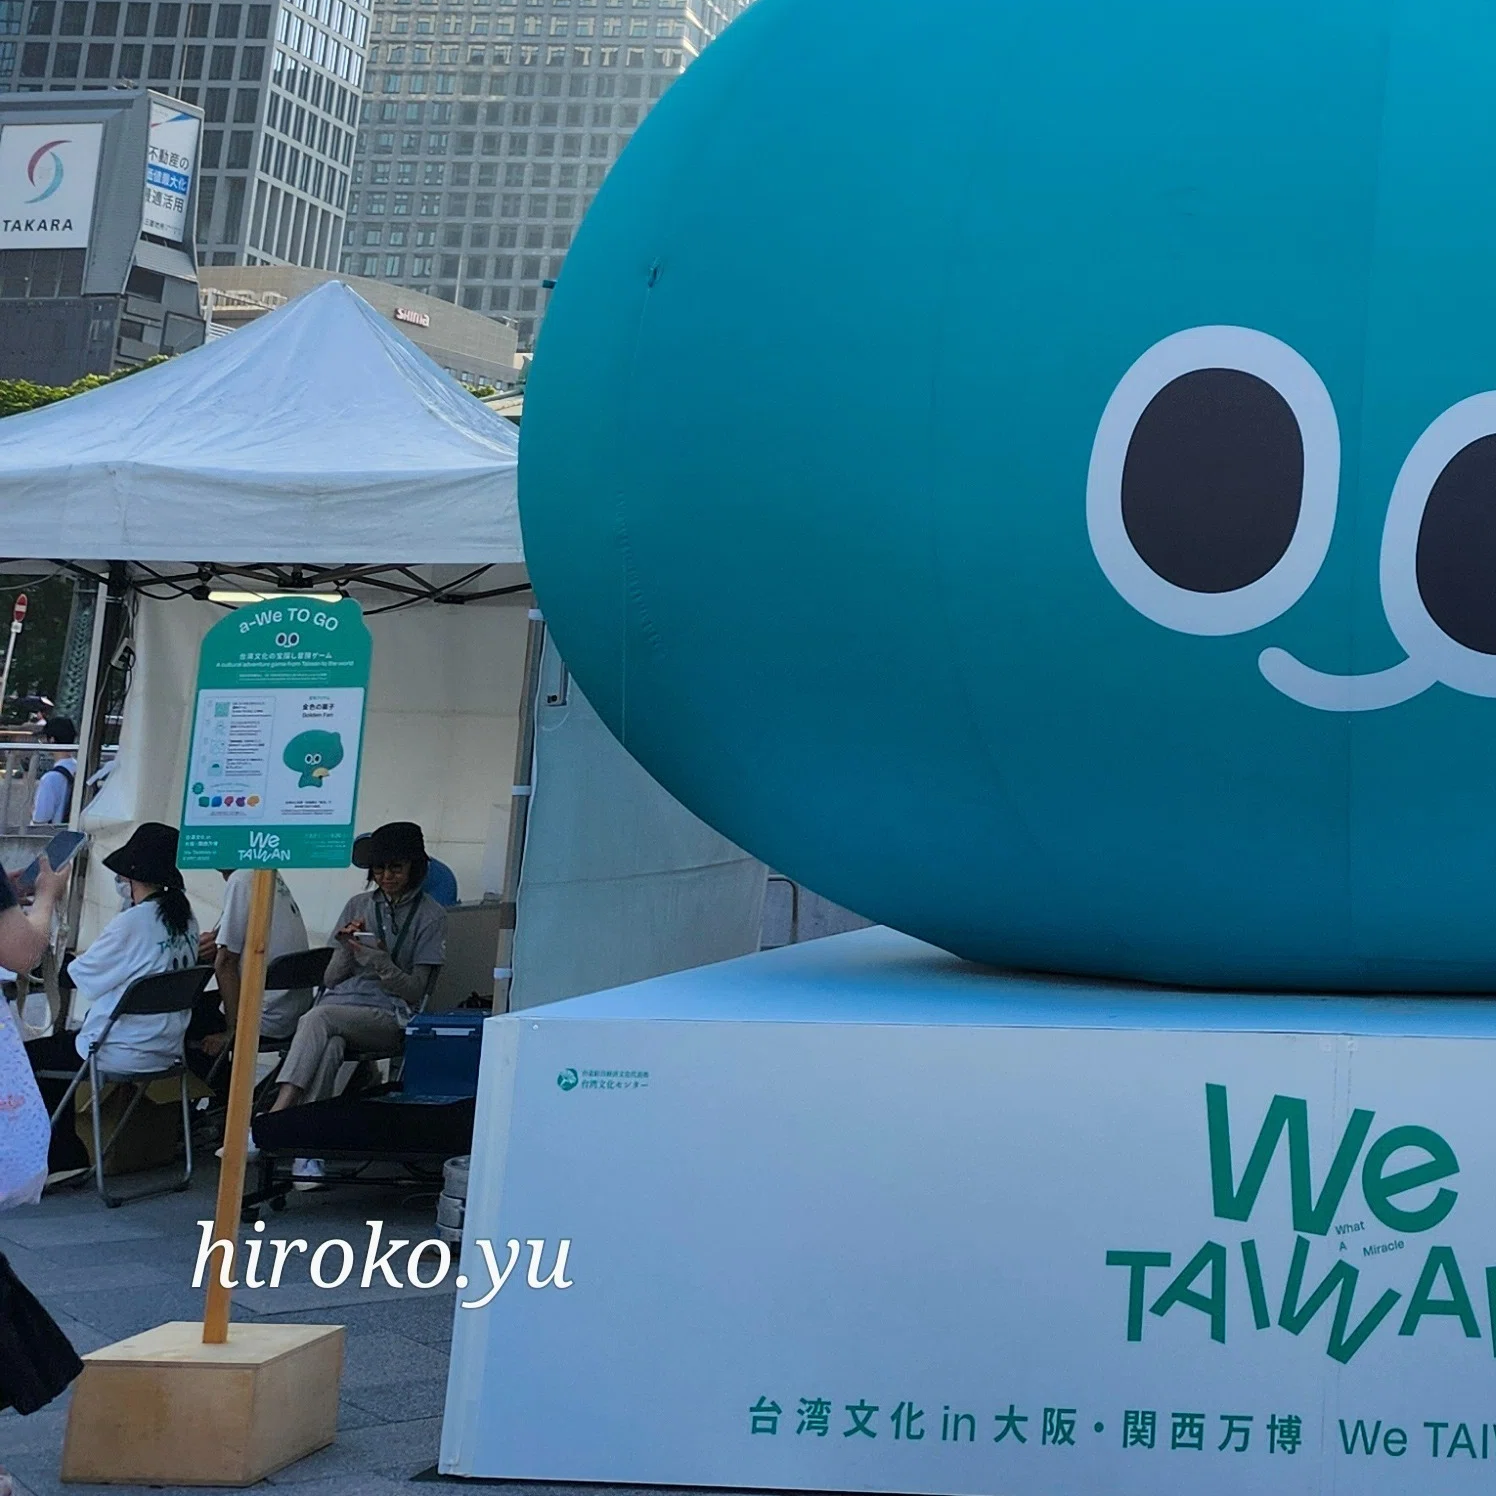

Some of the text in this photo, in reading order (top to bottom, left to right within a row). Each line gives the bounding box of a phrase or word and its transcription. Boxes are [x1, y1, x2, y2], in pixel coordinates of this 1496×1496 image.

[149, 145, 190, 171] 不動産の
[3, 218, 74, 232] TAKARA
[239, 607, 339, 634] a-We TO GO
[250, 831, 280, 848] We
[238, 849, 291, 863] TAIWAN
[1205, 1082, 1460, 1236] We
[1335, 1221, 1365, 1235] What
[1339, 1240, 1405, 1257] A Miracle
[1339, 1419, 1407, 1456] We
